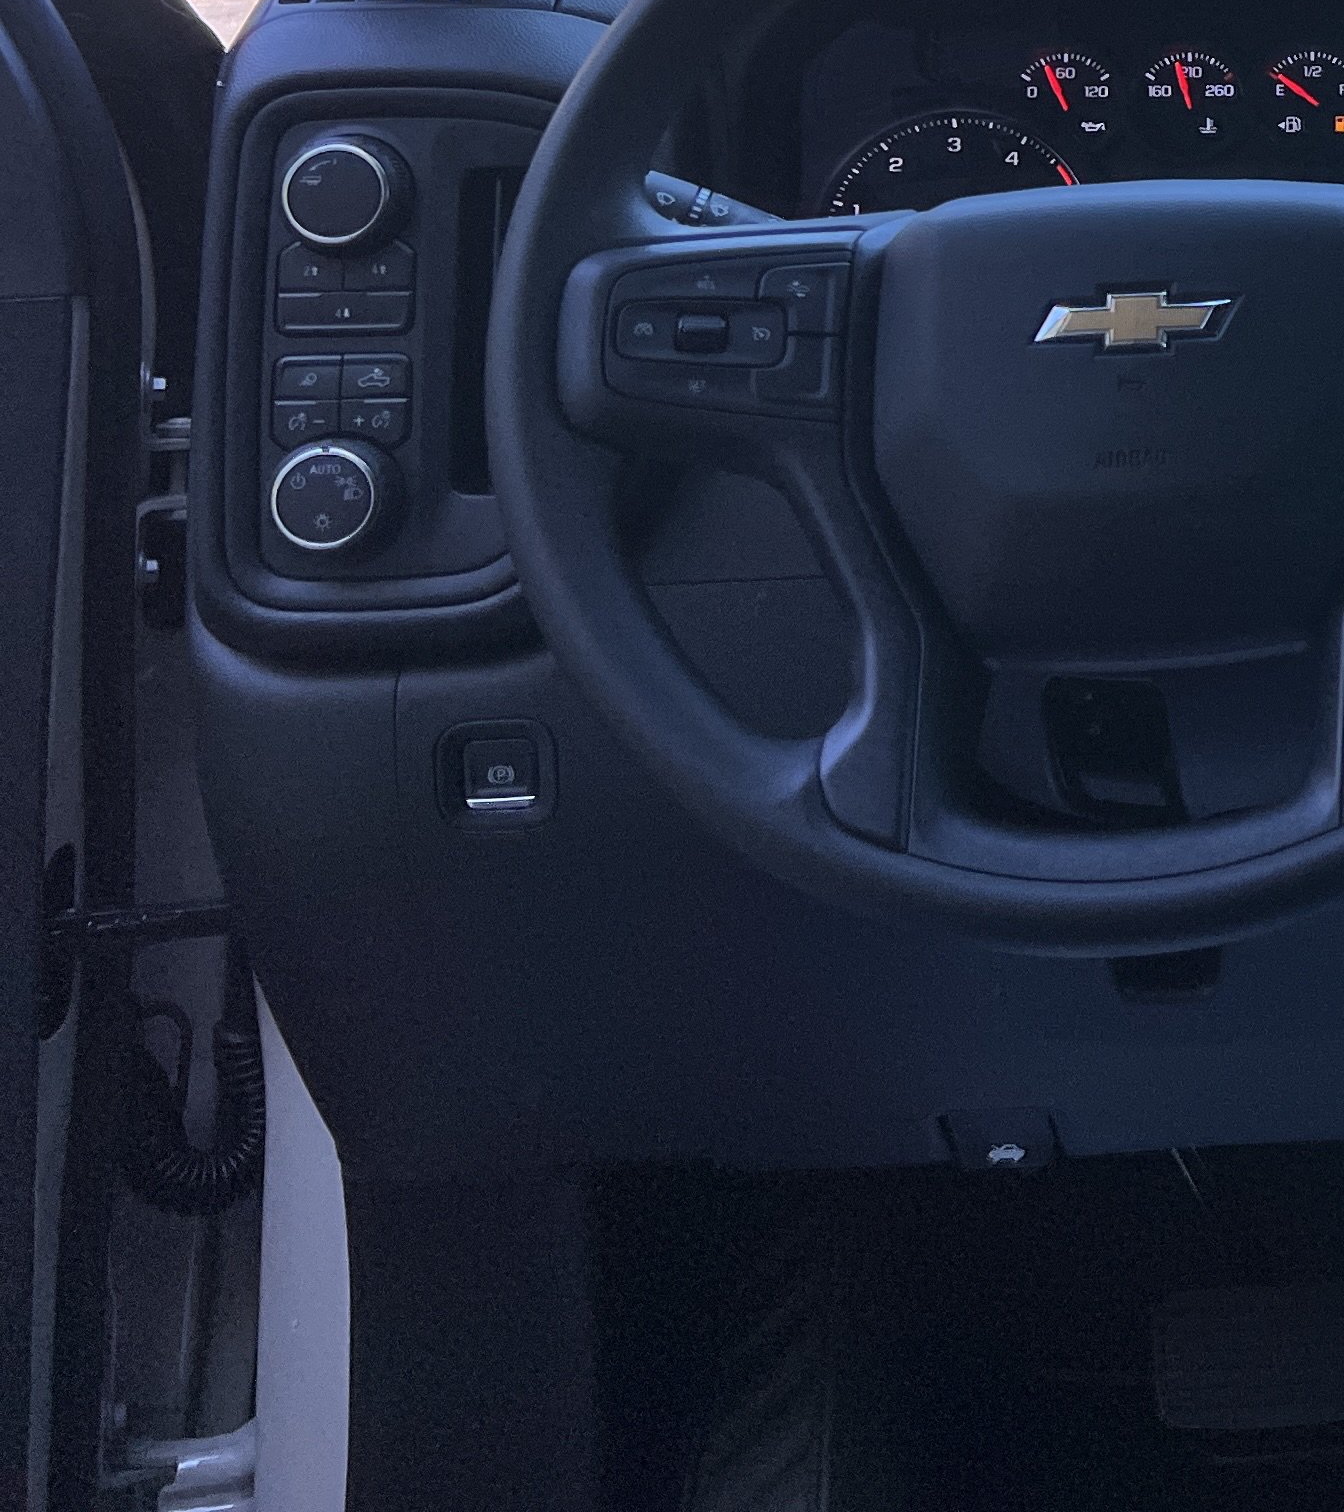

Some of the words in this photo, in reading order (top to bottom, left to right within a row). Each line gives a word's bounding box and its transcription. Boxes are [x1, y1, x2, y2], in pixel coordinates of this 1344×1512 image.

[1055, 67, 1076, 79] 60
[1303, 65, 1323, 78] 1/2
[1026, 86, 1038, 99] 0
[1084, 86, 1109, 98] 120
[1148, 85, 1172, 98] 160
[1205, 85, 1235, 98] 260
[1276, 85, 1286, 96] E
[946, 137, 962, 153] 3
[888, 157, 904, 172] 2
[1004, 151, 1019, 166] 4
[309, 464, 341, 475] AUTO
